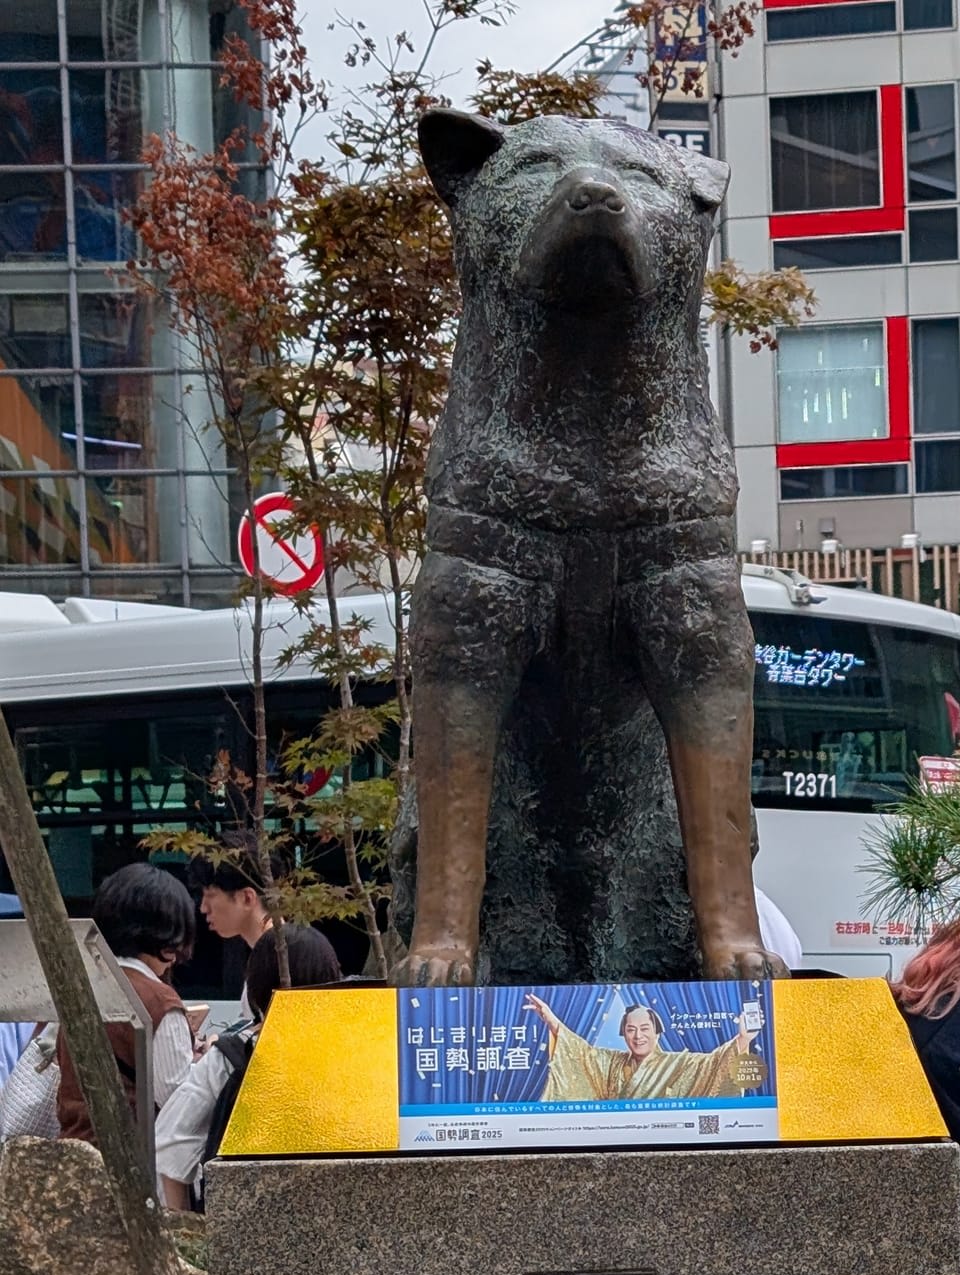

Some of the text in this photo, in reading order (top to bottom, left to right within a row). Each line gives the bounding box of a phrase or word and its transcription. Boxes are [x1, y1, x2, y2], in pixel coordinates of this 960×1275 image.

[782, 771, 837, 798] T2371
[407, 1024, 538, 1045] はじまります!
[416, 1046, 531, 1072] 国勢調査
